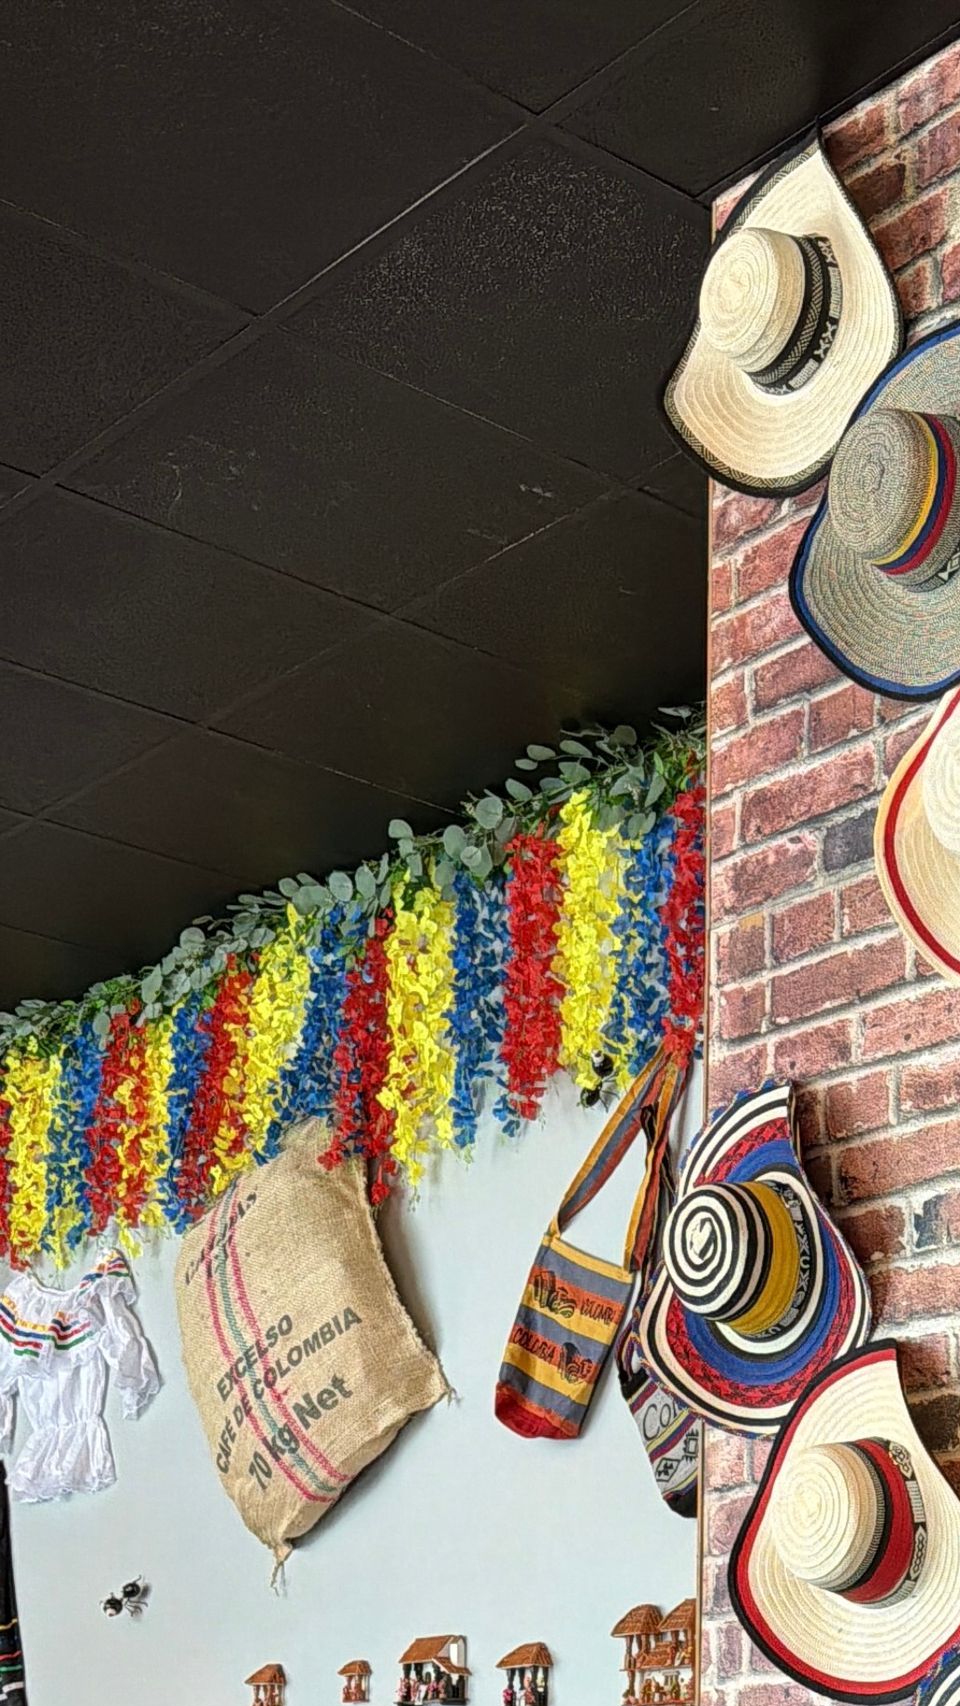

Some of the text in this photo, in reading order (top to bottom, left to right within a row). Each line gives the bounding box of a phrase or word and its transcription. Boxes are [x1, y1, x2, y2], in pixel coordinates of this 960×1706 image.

[216, 1314, 293, 1401] EXCELSO
[216, 1306, 363, 1475] CAFÉ DE COLOMBIA
[249, 1374, 354, 1491] 70 kg Net
